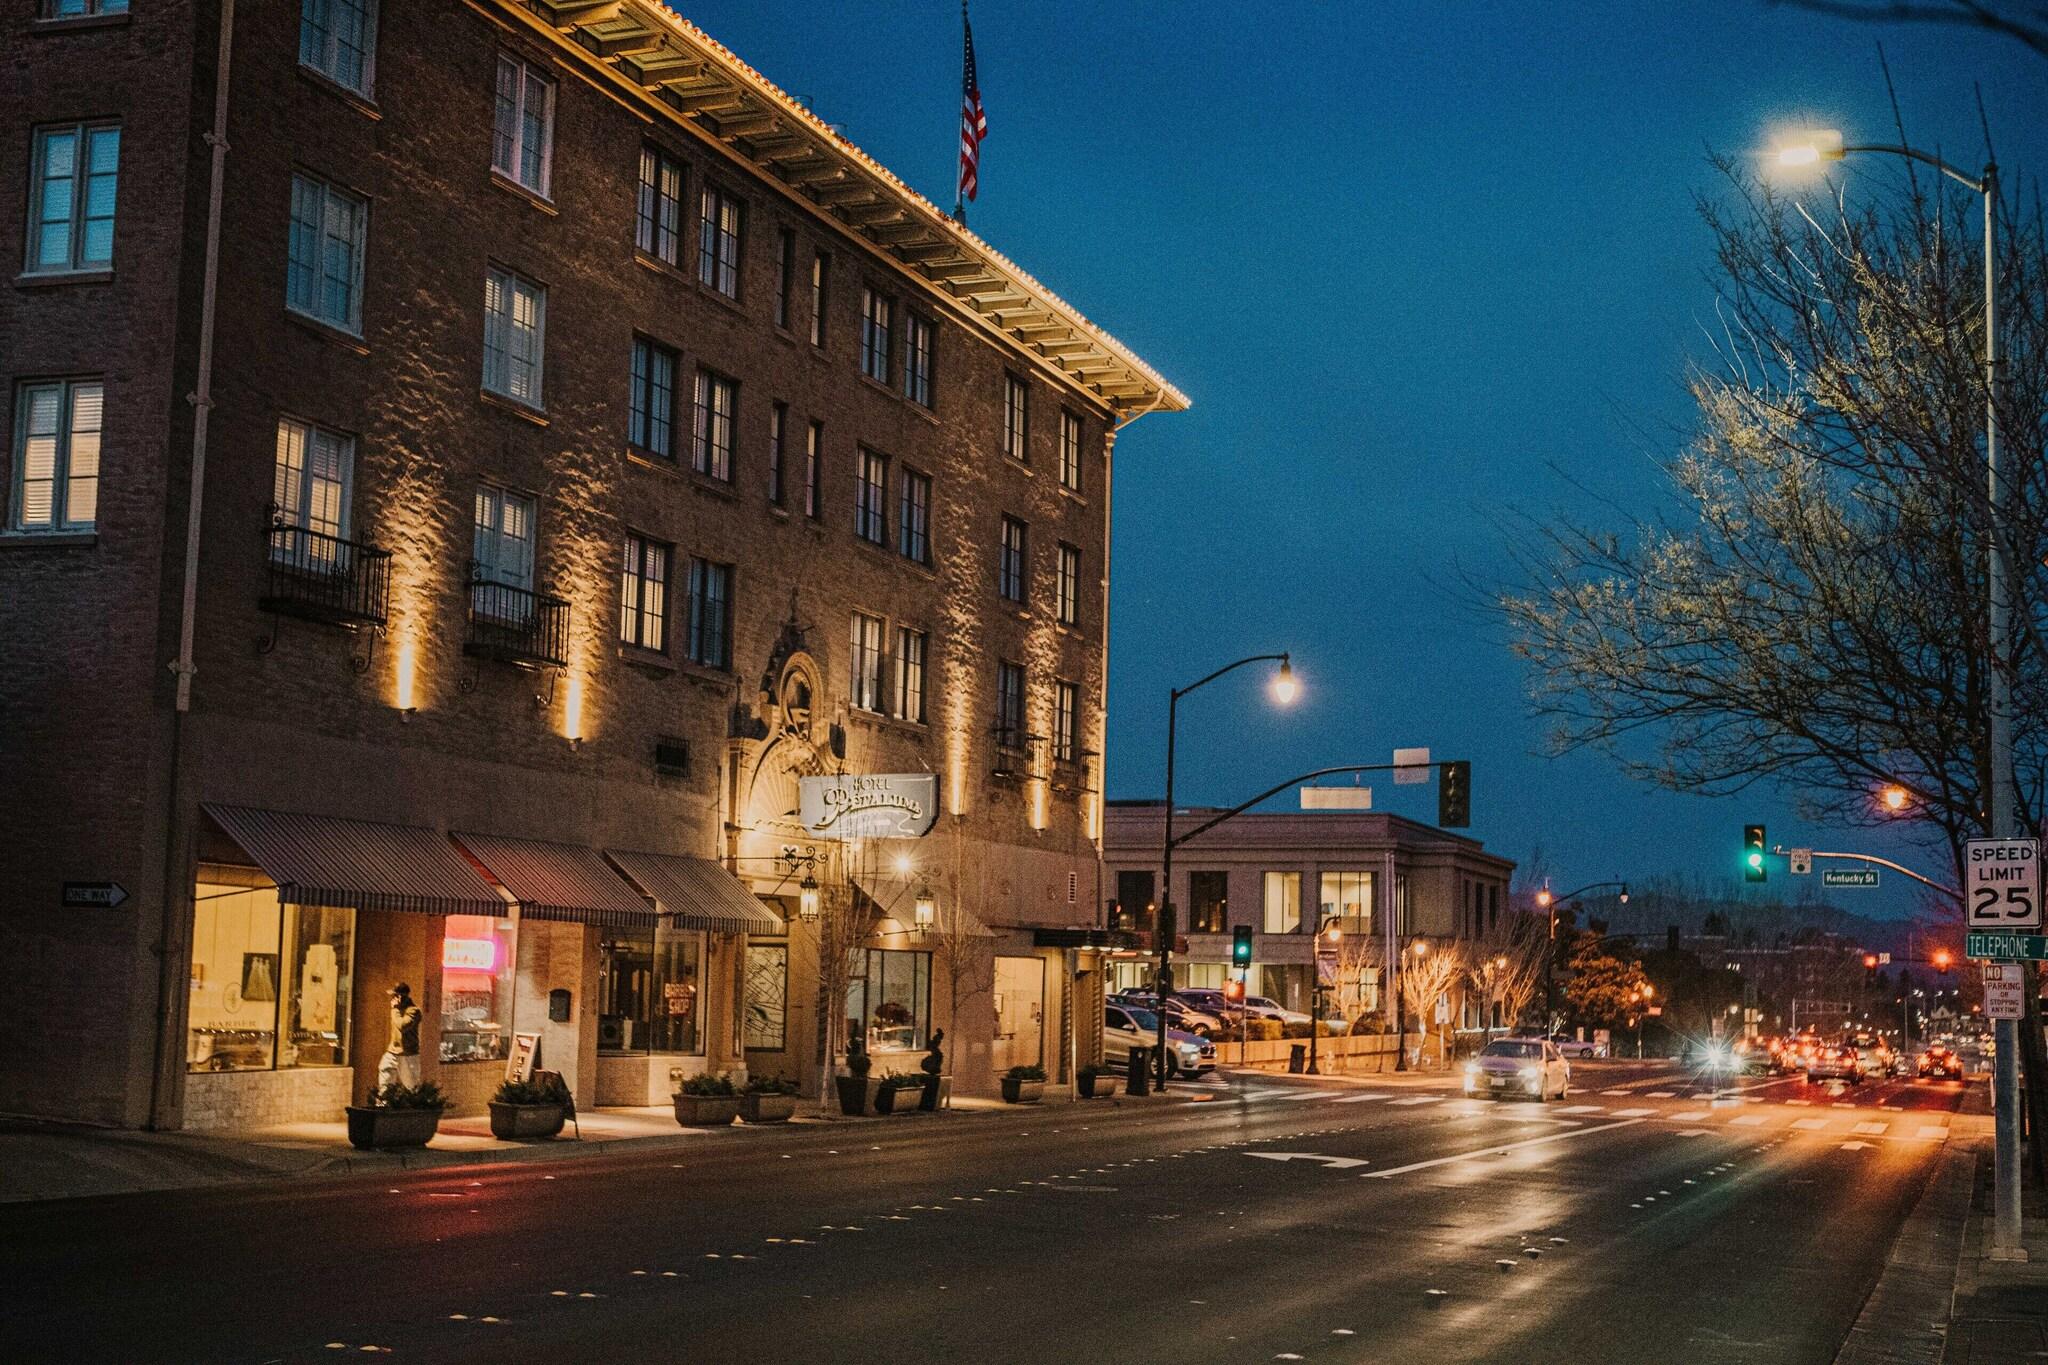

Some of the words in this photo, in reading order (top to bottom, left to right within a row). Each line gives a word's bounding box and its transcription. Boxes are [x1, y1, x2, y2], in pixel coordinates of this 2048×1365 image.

[853, 777, 892, 791] HOTEL
[1972, 847, 2032, 861] SPEED
[1826, 873, 1864, 884] Kentucky
[1865, 873, 1875, 883] St
[1979, 867, 2025, 881] LIMIT
[91, 889, 112, 900] WAY
[1974, 887, 2032, 918] 25
[1969, 936, 2030, 957] TELEPHONE
[1986, 967, 2001, 980] NO
[1987, 982, 2021, 991] PARKING
